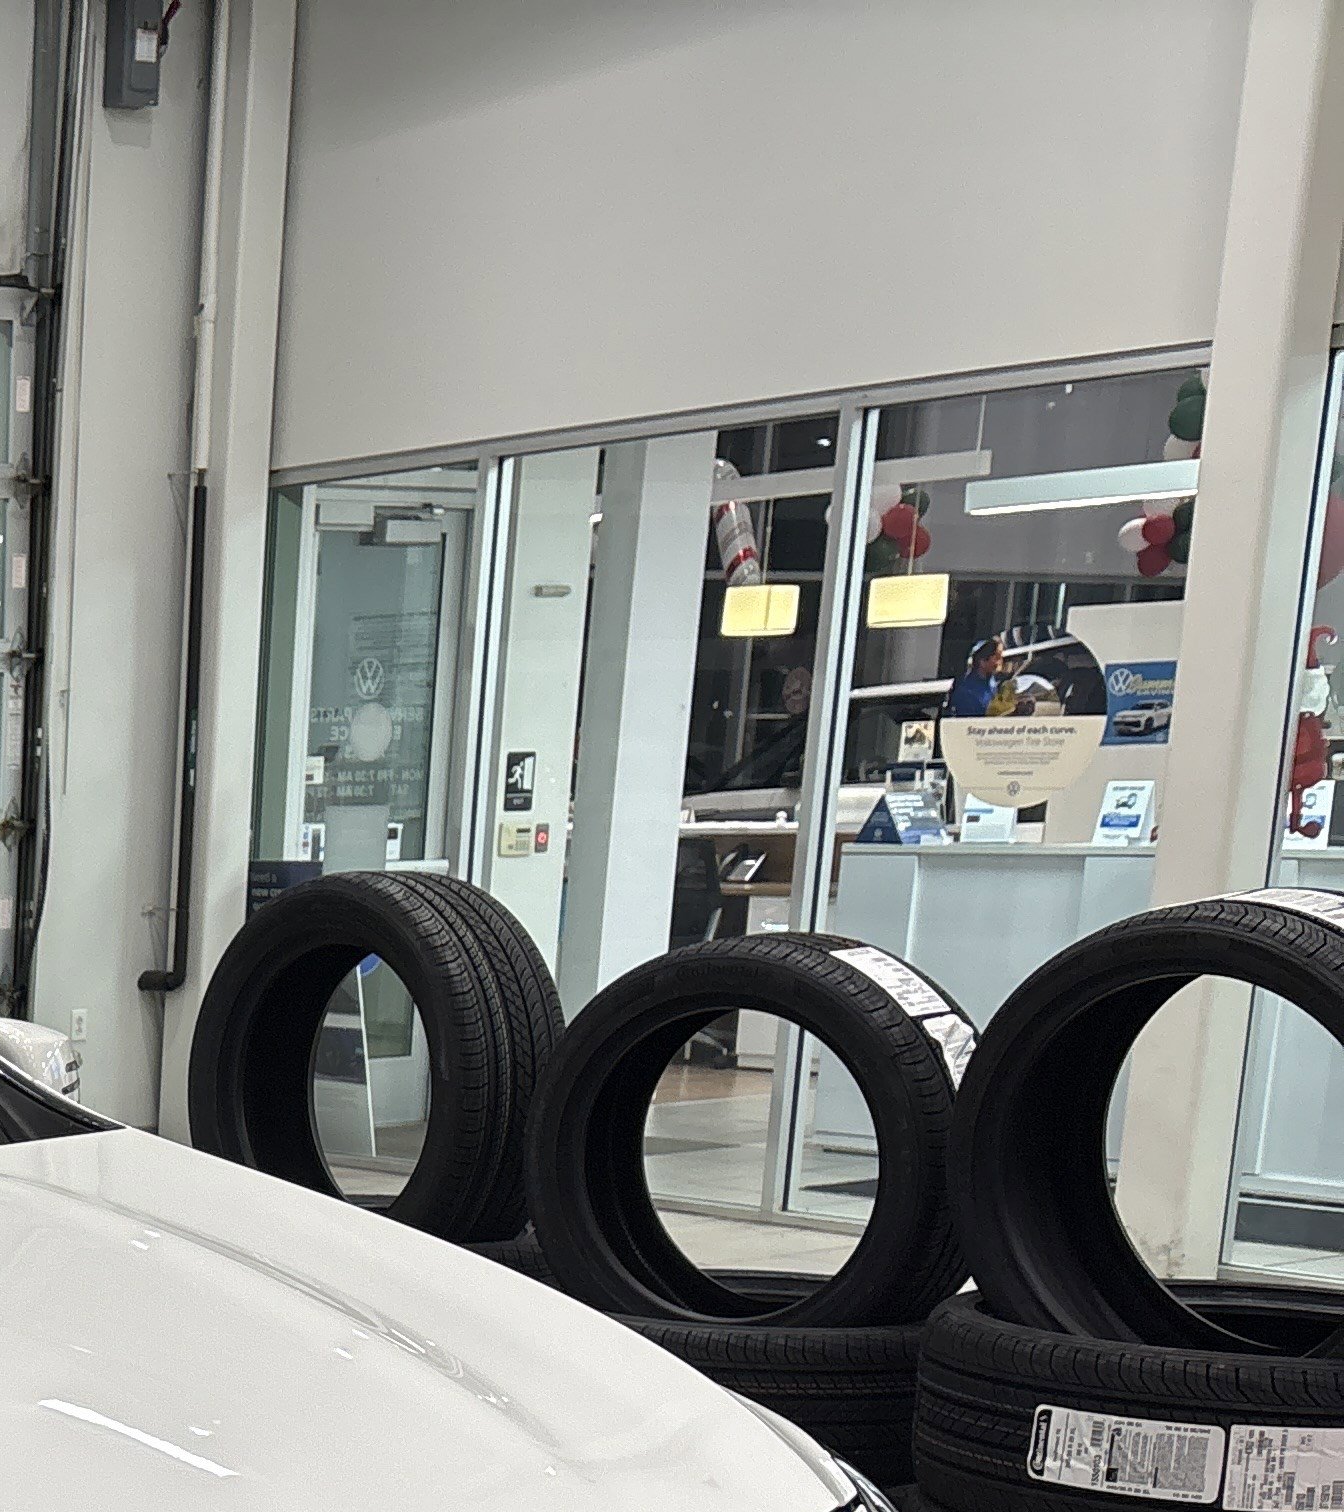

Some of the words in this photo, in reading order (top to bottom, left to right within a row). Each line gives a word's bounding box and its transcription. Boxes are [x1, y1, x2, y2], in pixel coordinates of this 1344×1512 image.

[967, 726, 986, 736] Stay
[988, 725, 1014, 735] ahead
[1016, 725, 1027, 735] of
[1027, 725, 1048, 735] each
[1049, 726, 1077, 735] curve.
